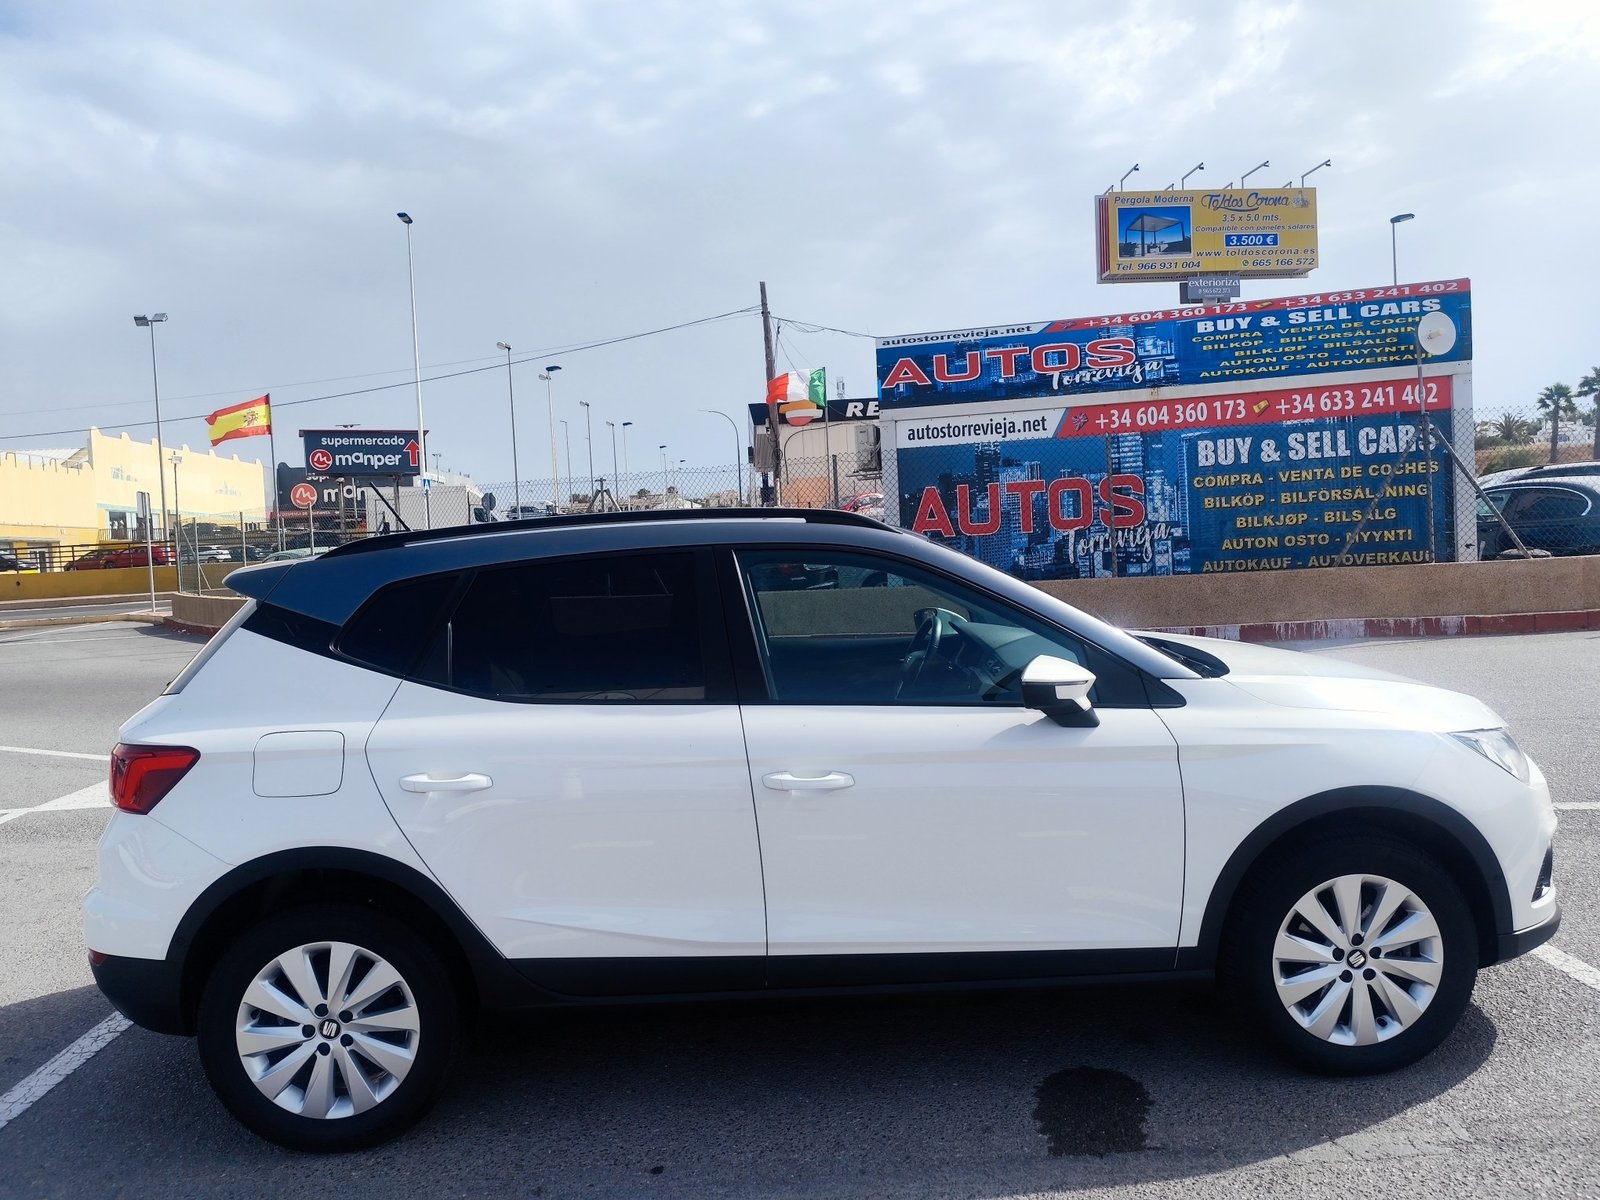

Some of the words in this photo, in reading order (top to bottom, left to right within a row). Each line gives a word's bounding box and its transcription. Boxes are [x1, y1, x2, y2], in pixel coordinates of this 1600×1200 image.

[1153, 195, 1194, 203] Moderna
[1200, 194, 1243, 212] Toldos
[1246, 192, 1290, 208] Corona
[1222, 214, 1236, 222] 3,5
[1246, 213, 1260, 222] 5,0
[1195, 225, 1239, 233] Compatible
[1256, 224, 1286, 232] paneles
[1229, 235, 1263, 246] 3.500
[1266, 235, 1275, 245] €
[1196, 247, 1316, 257] www.toldoscorona.es
[1116, 263, 1134, 271] Tel.
[1137, 262, 1157, 270] 966
[1159, 261, 1178, 270] 931
[1181, 260, 1201, 269] 004
[1252, 259, 1272, 267] 665
[1295, 257, 1315, 266] 572
[1188, 277, 1240, 287] exterioriza
[1280, 295, 1322, 307] +34
[1328, 291, 1366, 302] 633
[1373, 286, 1411, 298] 241
[1418, 282, 1458, 293] 402
[1084, 315, 1124, 327] +34
[1128, 312, 1165, 322] 604
[1169, 307, 1206, 318] 360
[1212, 303, 1248, 314] 173
[1197, 316, 1252, 333] BUY
[1260, 316, 1280, 327] &
[1288, 307, 1352, 324] SELL
[1360, 299, 1441, 318] CARS
[882, 325, 1032, 346] autostorrevieja.net
[1192, 331, 1262, 343] COMPRA
[1279, 325, 1335, 335] VENTA
[1341, 321, 1363, 329] DE
[1202, 340, 1263, 351] BILKÖP
[1234, 345, 1307, 357] BILKJØP
[1323, 337, 1398, 349] BILSALG
[881, 337, 1136, 389] AUTOS
[1220, 356, 1277, 367] AUTON
[1283, 352, 1328, 360] OSTO
[1346, 344, 1414, 356] MYYNTI
[1046, 360, 1163, 390] Torrevieja
[1200, 365, 1290, 378] AUTOKAUF
[1276, 393, 1315, 415] +34
[1320, 390, 1356, 412] 633
[1360, 386, 1395, 408] 241
[1401, 383, 1438, 405] 402
[1095, 409, 1132, 430] +34
[1136, 406, 1169, 426] 604
[1173, 402, 1208, 422] 360
[1213, 399, 1246, 420] 173
[907, 415, 1048, 441] autostorrevieja.net
[321, 436, 405, 448] supermercado
[1197, 437, 1252, 467] BUY
[1260, 439, 1280, 463] &
[1287, 429, 1351, 460] SELL
[335, 452, 402, 470] manper
[1193, 473, 1264, 488] COMPRA
[1279, 467, 1335, 482] VENTA
[1341, 466, 1363, 478] DE
[911, 473, 1145, 537] AUTOS
[1204, 493, 1265, 508] BILKÖP
[1236, 513, 1308, 528] BILKJØP
[1221, 536, 1279, 550] AUTON
[1284, 533, 1330, 547] OSTO
[1202, 557, 1292, 573] AUTOKAUF
